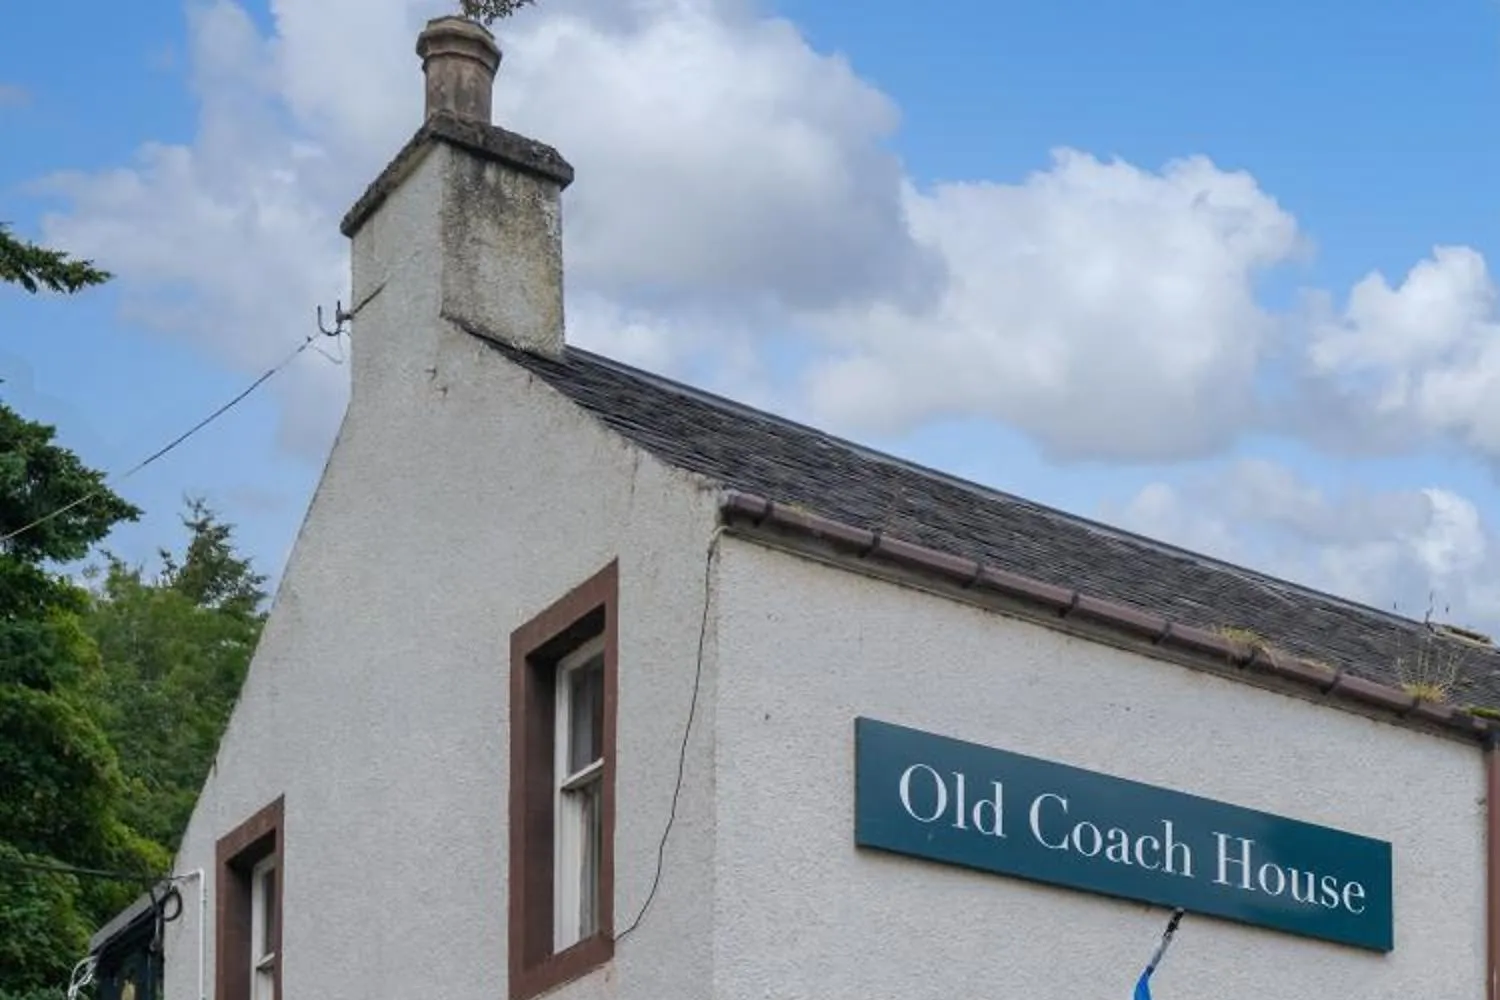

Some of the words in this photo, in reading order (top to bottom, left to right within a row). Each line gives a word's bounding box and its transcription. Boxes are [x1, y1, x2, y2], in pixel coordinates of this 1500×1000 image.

[898, 763, 1007, 838] Old
[1029, 792, 1195, 878] Coach
[1210, 832, 1366, 914] House
